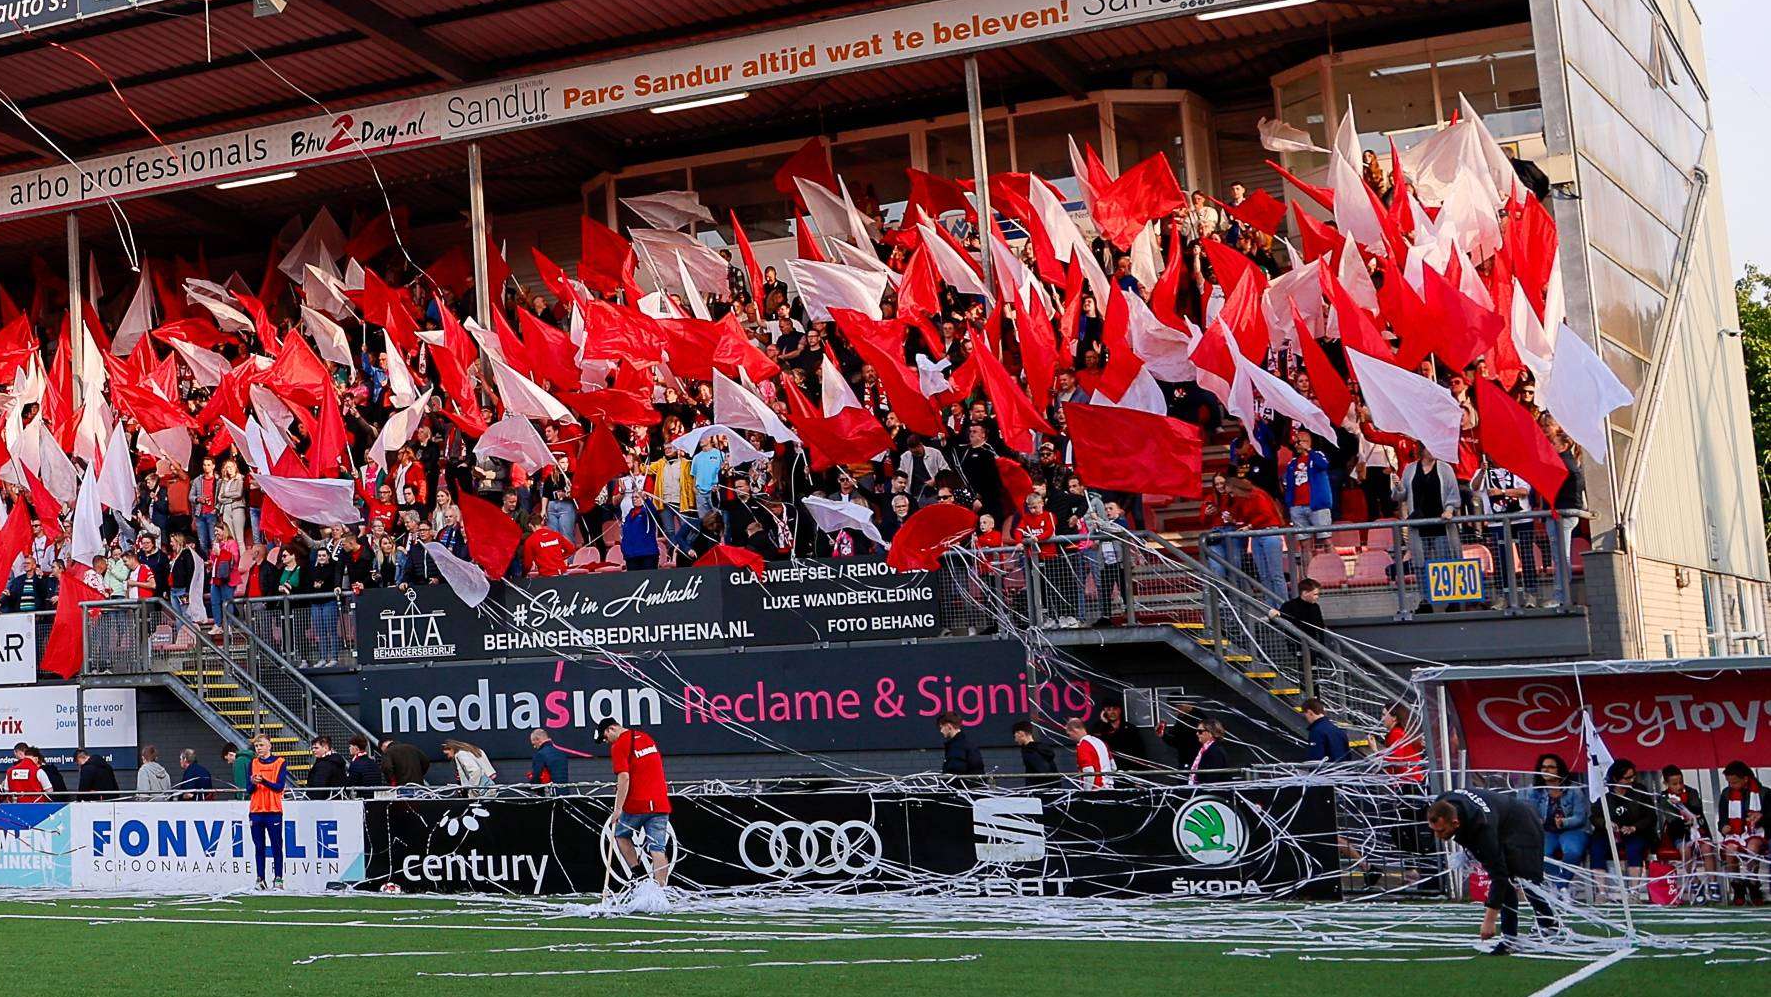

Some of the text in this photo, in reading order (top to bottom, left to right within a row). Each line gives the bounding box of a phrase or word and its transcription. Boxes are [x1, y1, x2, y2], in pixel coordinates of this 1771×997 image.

[563, 0, 1070, 110] Parc Sandur altijd wat te beleven!
[448, 83, 550, 128] Sandur
[290, 111, 426, 157] Bhv2Day.nl
[10, 133, 269, 207] arbo professionals
[729, 564, 836, 586] GLASWEEFSEL
[1432, 565, 1479, 598] 29/30
[580, 596, 598, 615] in
[602, 575, 703, 618] Ambacht
[763, 587, 934, 610] LUXE WANDBEKLEDING
[484, 619, 755, 652] BEHANGERSBEDRIJFHENA.NL
[827, 613, 935, 633] FOTO BEHANG
[374, 645, 457, 660] BEHANGERSBEDRIJF
[56, 704, 68, 714] De
[103, 704, 123, 713] voor
[684, 680, 861, 725] Reclame
[873, 676, 906, 718] &
[918, 671, 1094, 728] Signing
[56, 717, 114, 730] jouw doel
[403, 849, 549, 895] century
[1171, 877, 1263, 895] ŠKODA
